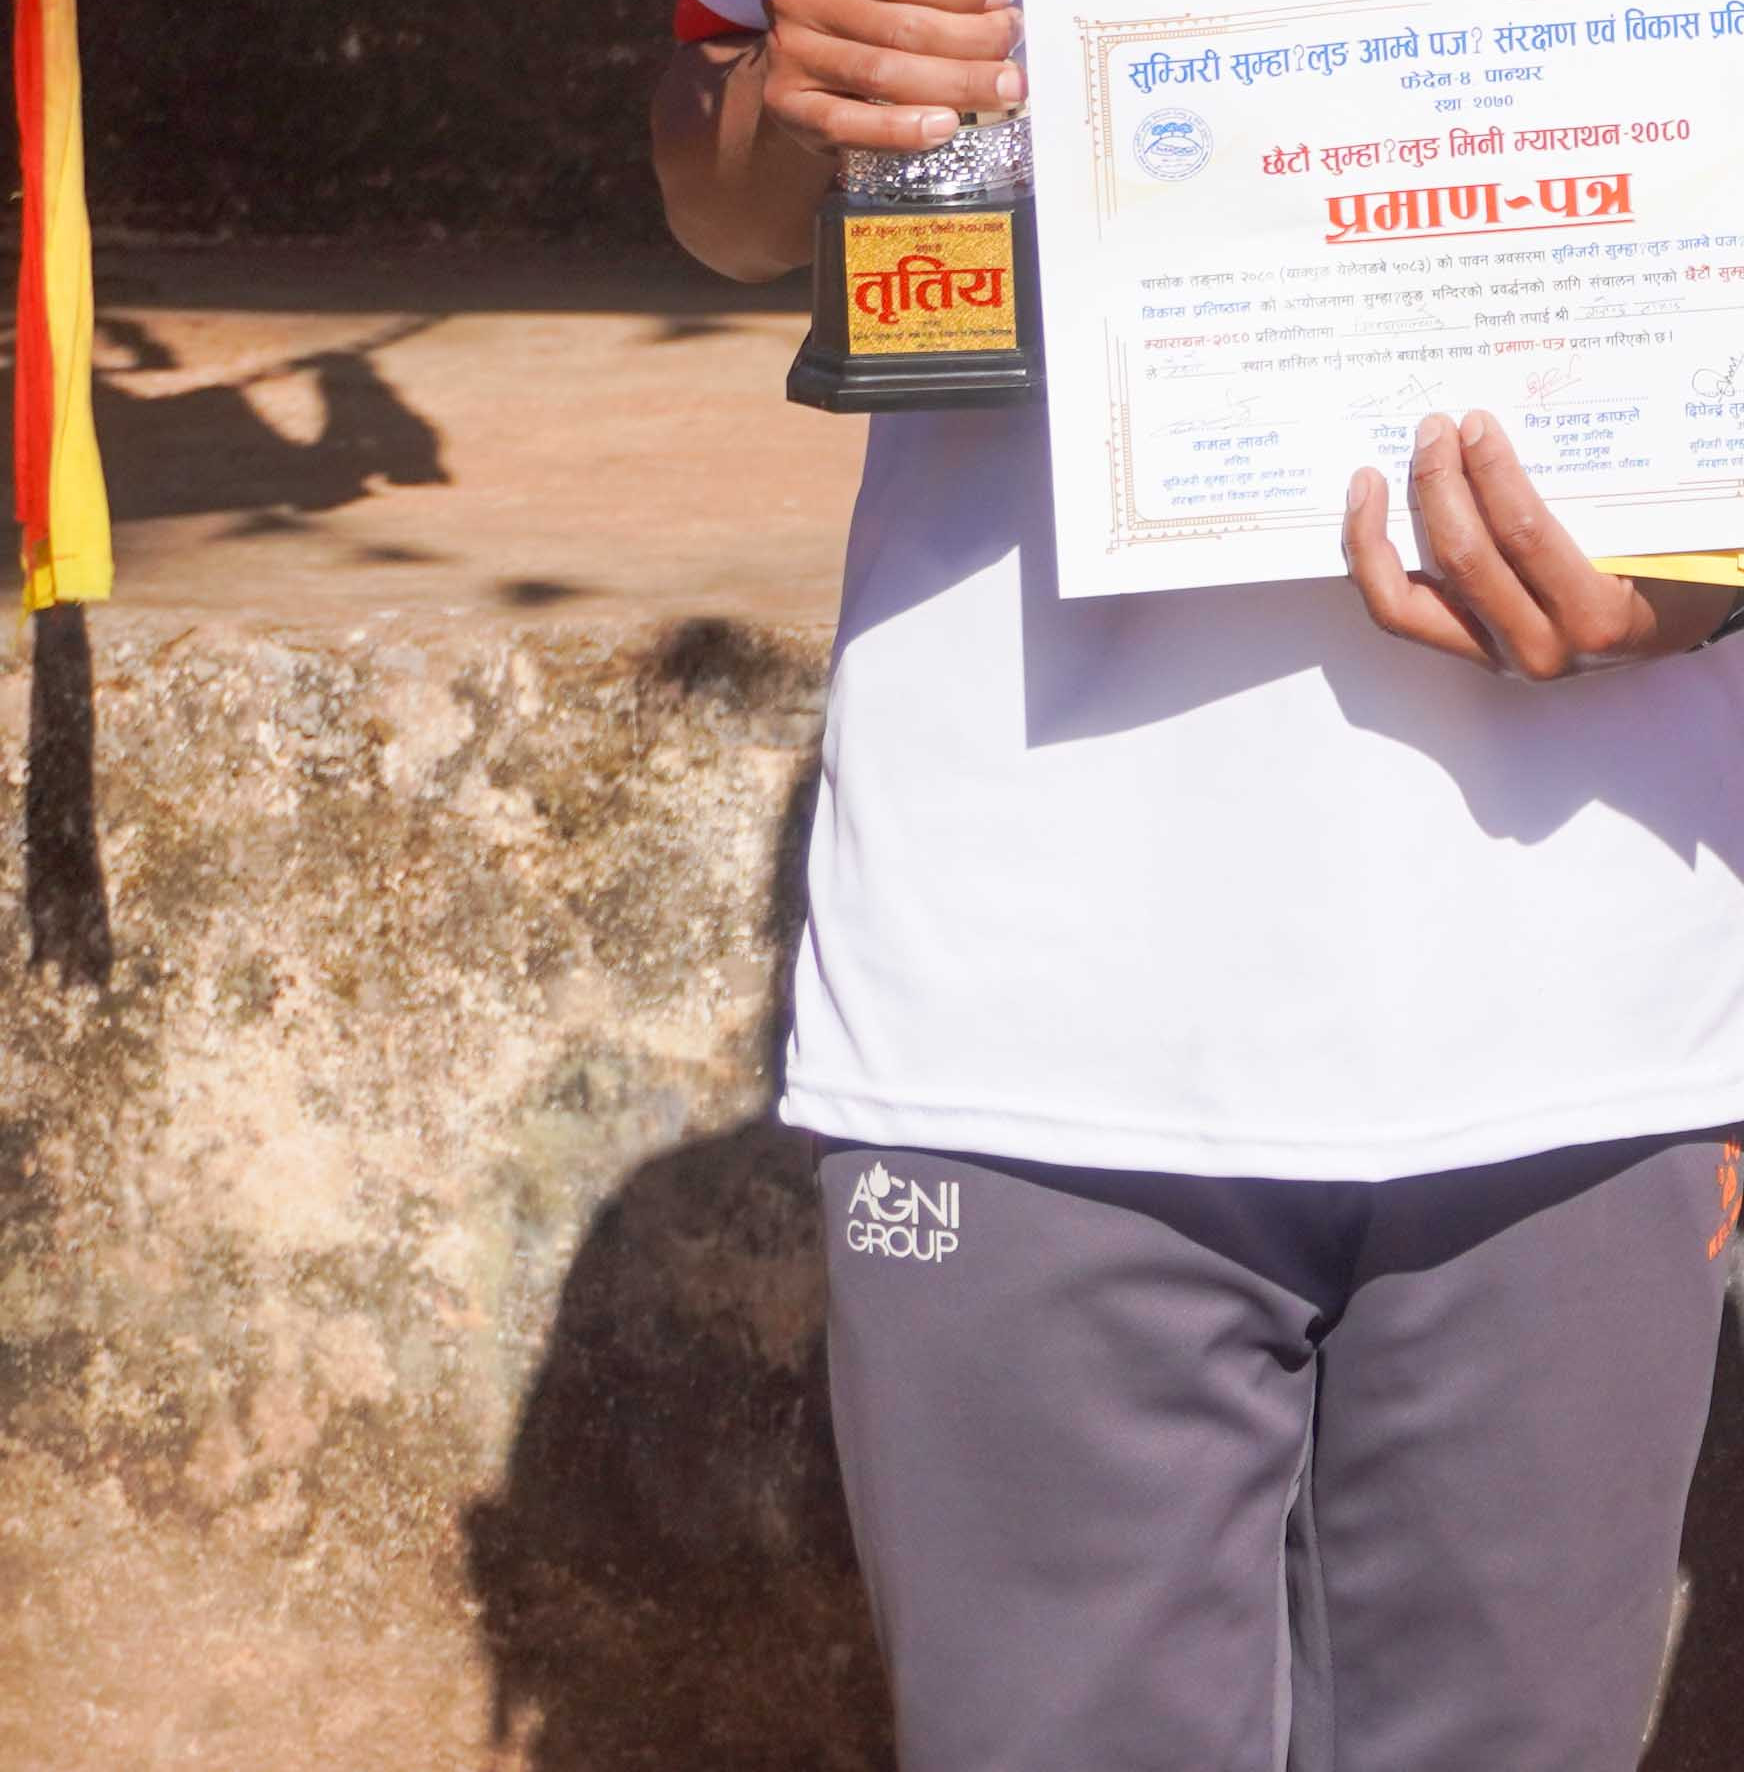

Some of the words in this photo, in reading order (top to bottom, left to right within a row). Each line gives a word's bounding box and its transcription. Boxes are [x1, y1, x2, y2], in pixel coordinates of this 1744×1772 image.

[1359, 27, 1420, 64] आम्बे
[1493, 21, 1577, 54] संरक्षण
[1586, 14, 1616, 45] एवं
[1624, 7, 1701, 42] विकास
[1449, 125, 1505, 158] मिनी
[1324, 173, 1635, 242] प्रमाण-पत्र
[848, 1166, 960, 1229] AGNI
[847, 1219, 959, 1263] GROUP
